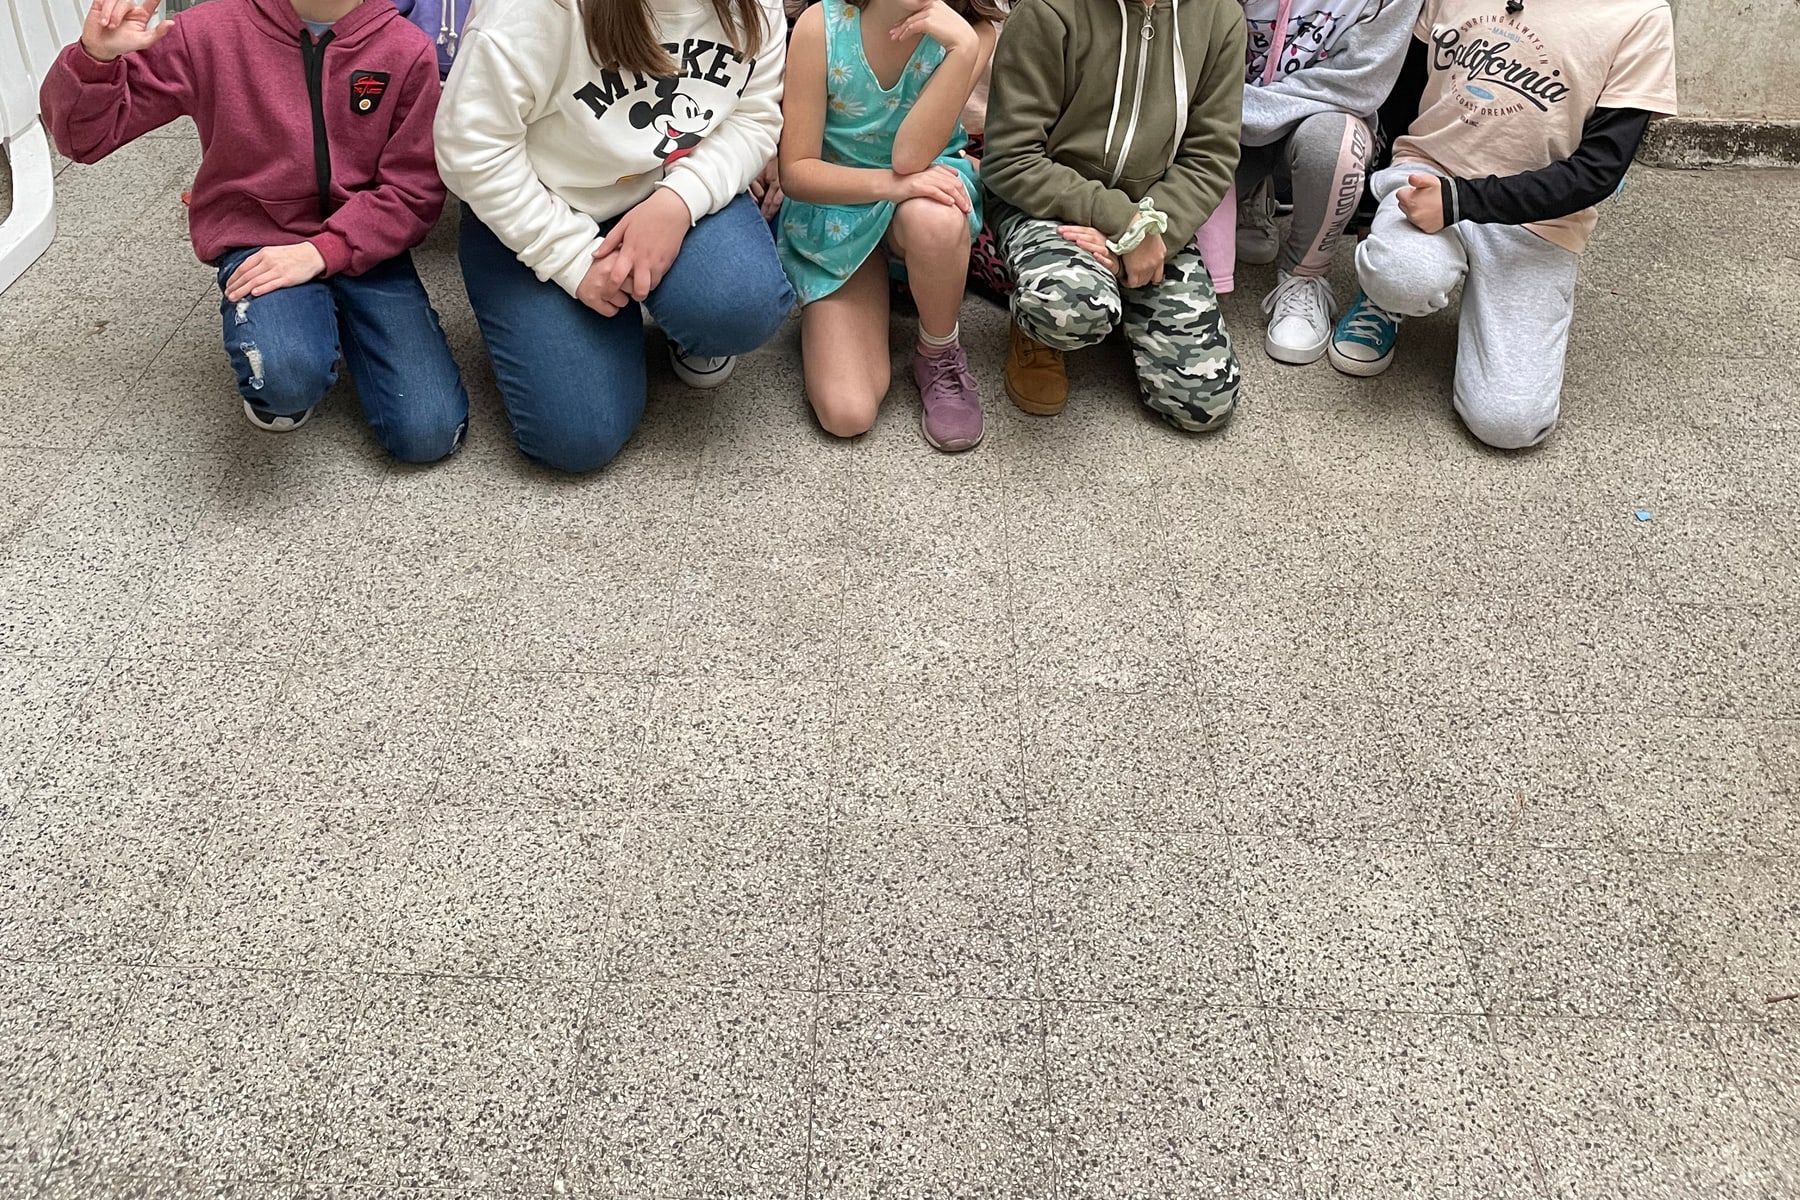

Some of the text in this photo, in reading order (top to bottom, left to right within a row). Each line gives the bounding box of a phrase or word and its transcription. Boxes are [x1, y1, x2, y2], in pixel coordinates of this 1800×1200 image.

[1461, 15, 1505, 33] SURFING
[1508, 18, 1544, 51] ALWAYS
[1432, 28, 1570, 103] California
[1335, 173, 1360, 216] GOOD
